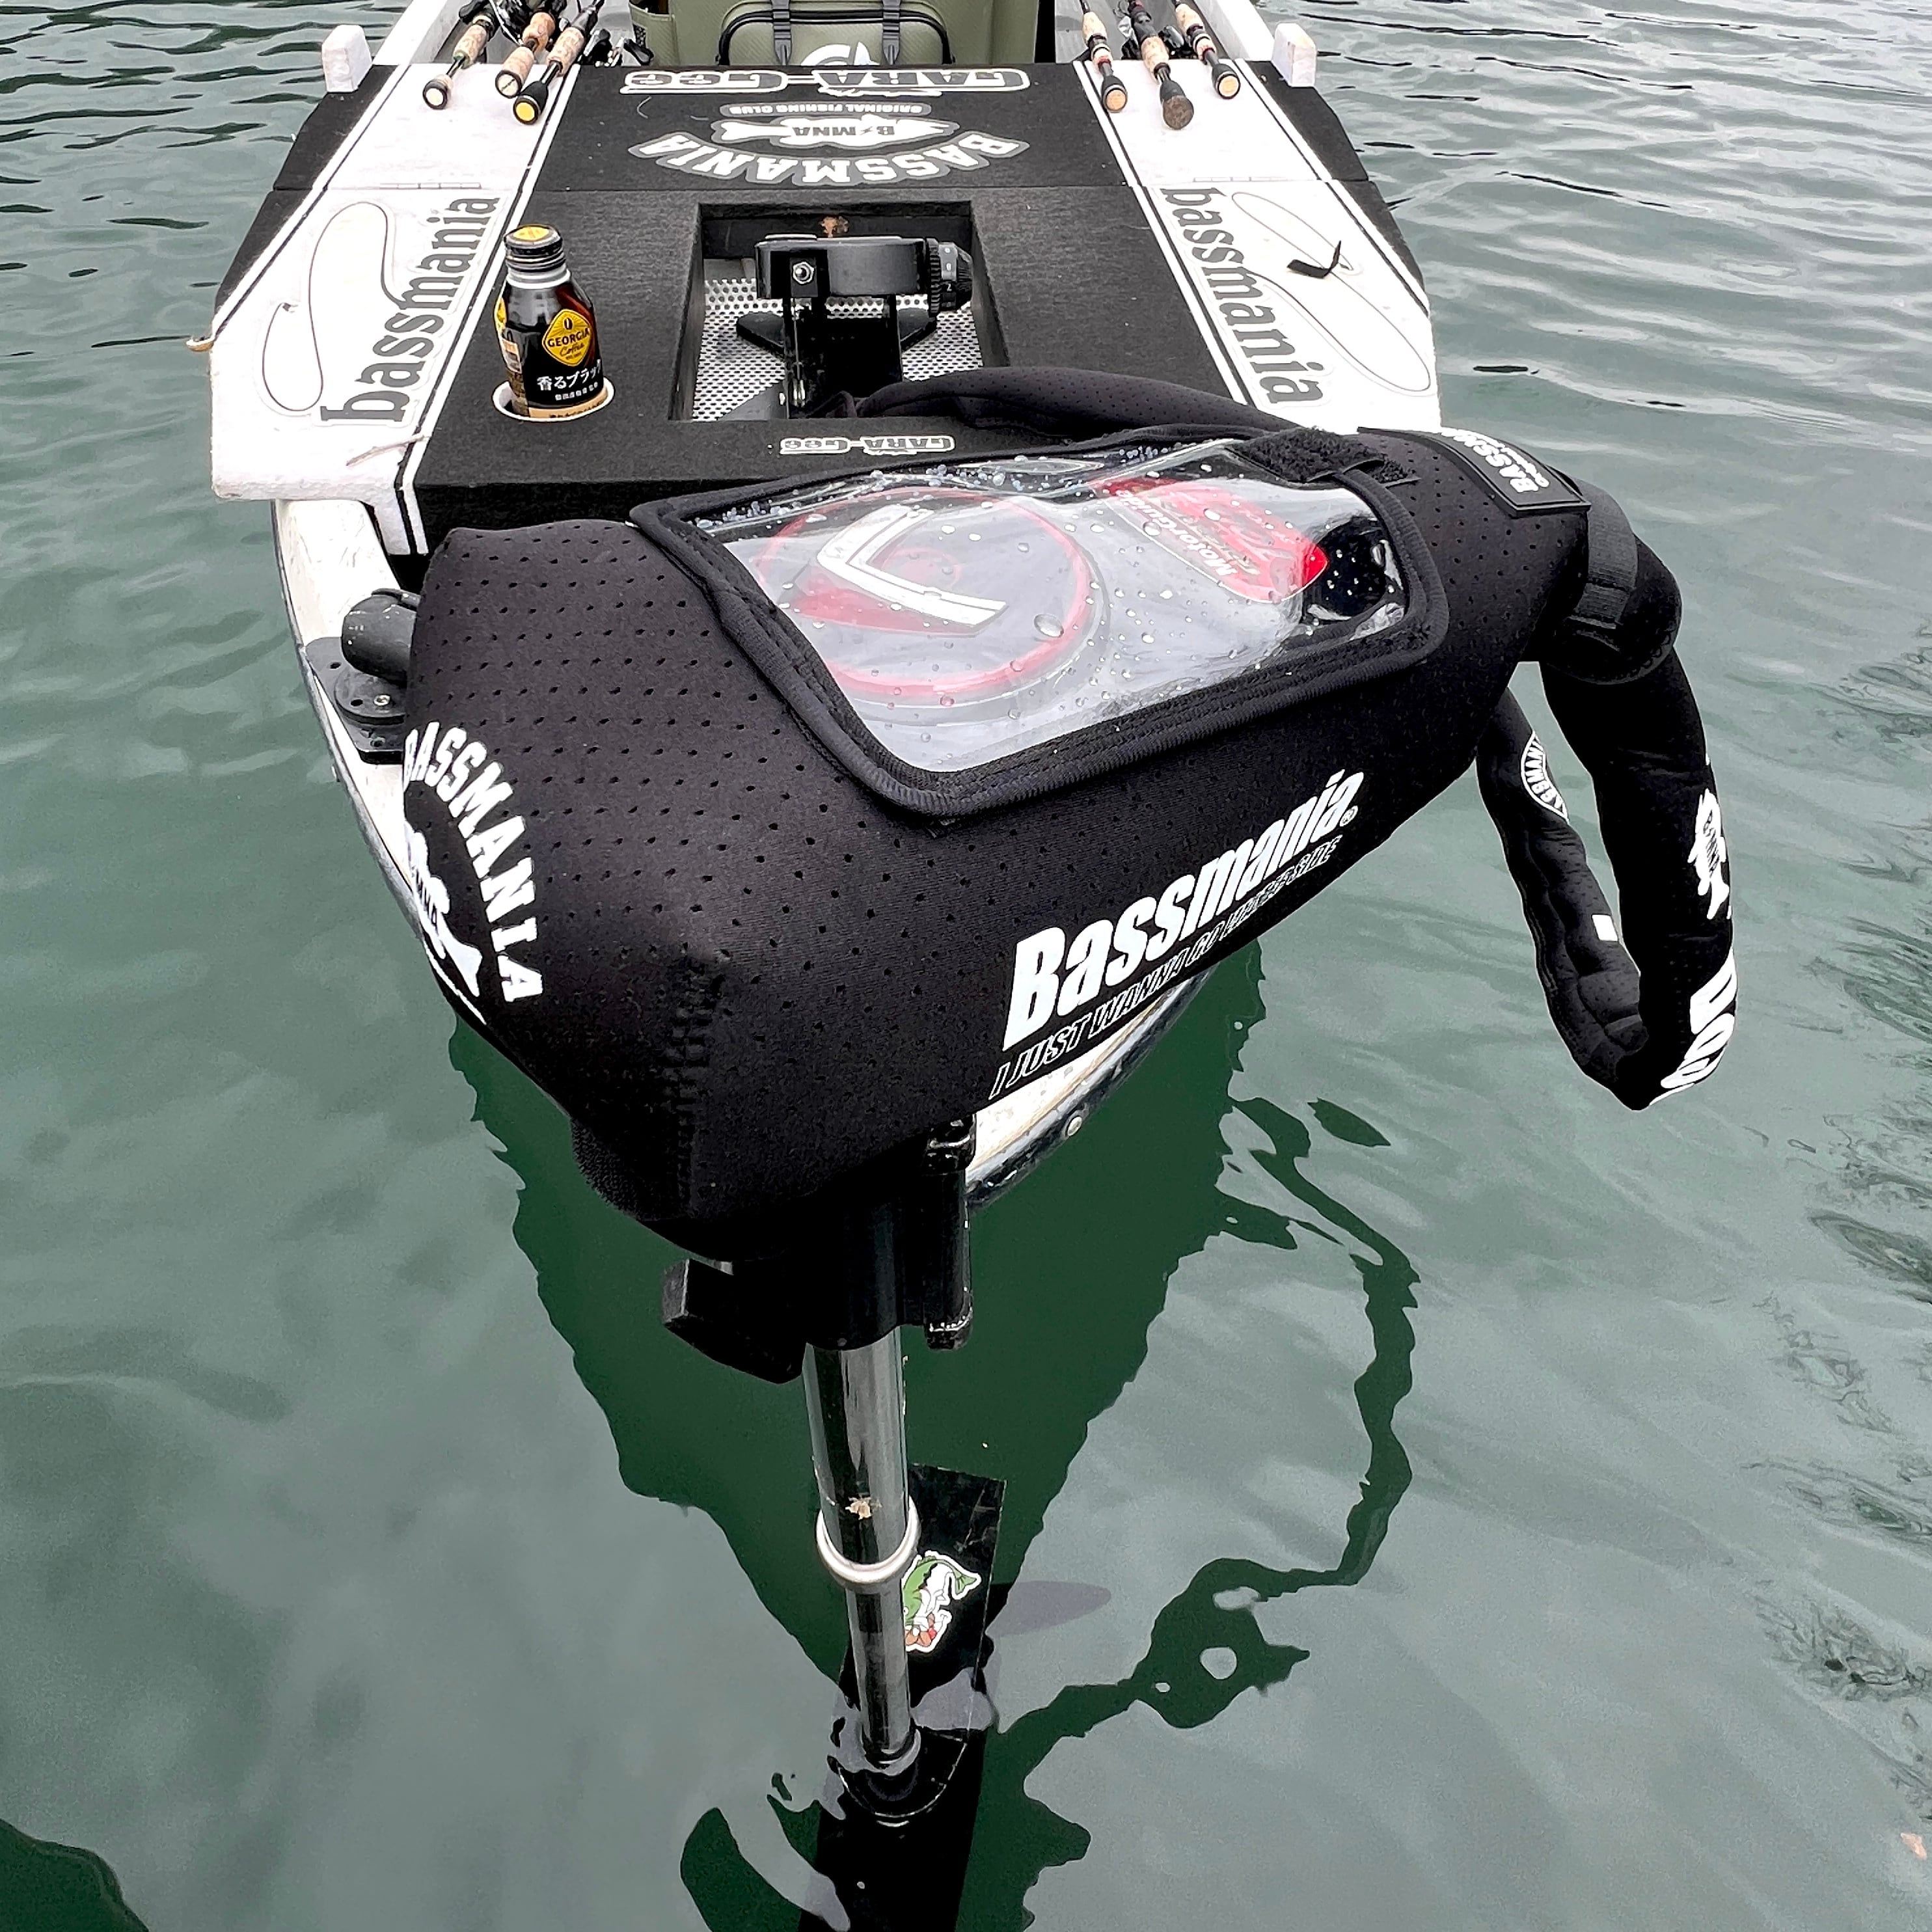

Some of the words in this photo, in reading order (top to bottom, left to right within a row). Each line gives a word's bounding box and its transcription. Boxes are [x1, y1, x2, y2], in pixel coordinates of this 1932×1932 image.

[729, 105, 773, 115] CLUB
[776, 103, 843, 113] FISHING
[638, 133, 1022, 184] BASSMANIA
[320, 197, 500, 422] bassmania
[547, 327, 590, 347] GEORGIA
[1162, 187, 1324, 404] bassmania
[1117, 489, 1238, 577] MotorGuide
[403, 721, 544, 1003] BASSMANIA
[988, 1061, 1011, 1100] I
[1005, 1012, 1093, 1089] JUST
[1087, 947, 1191, 1040] WANNA
[1185, 920, 1225, 967] GO
